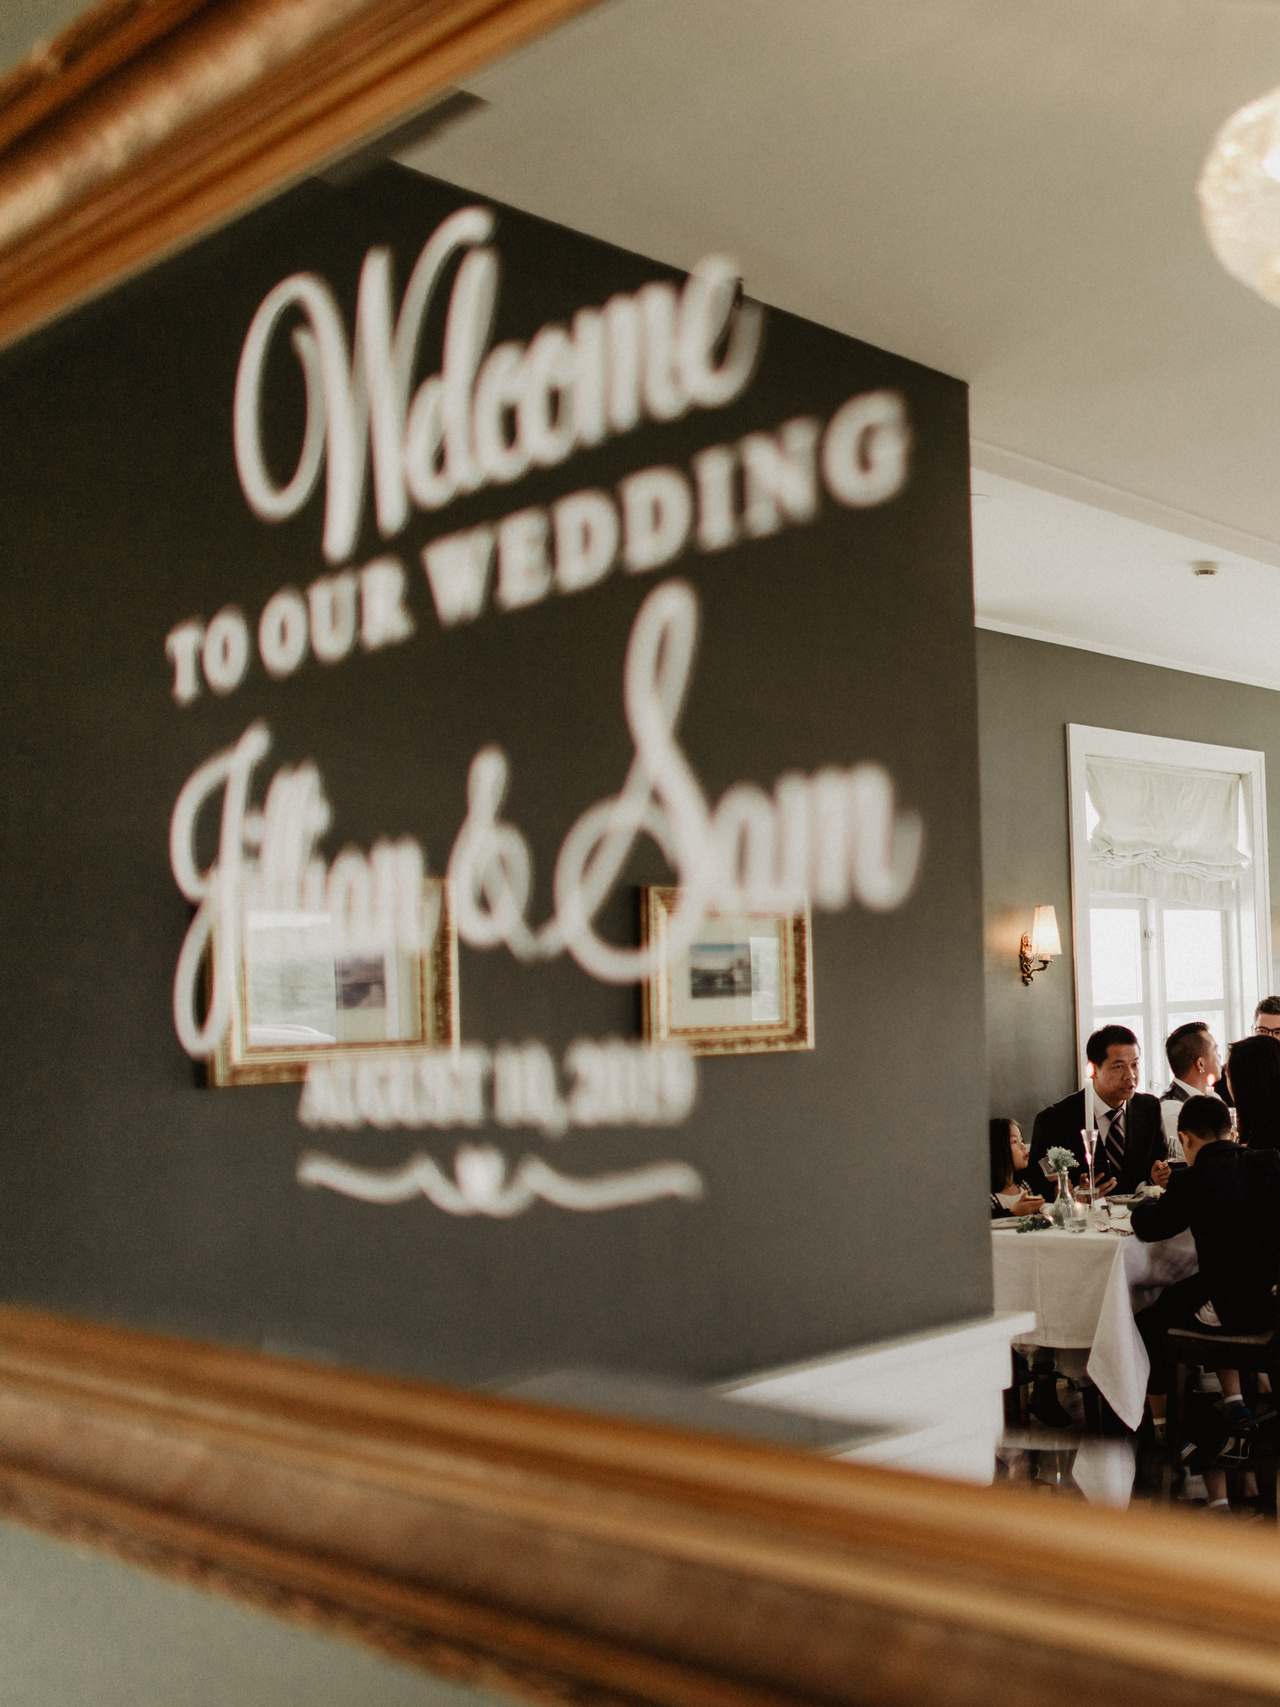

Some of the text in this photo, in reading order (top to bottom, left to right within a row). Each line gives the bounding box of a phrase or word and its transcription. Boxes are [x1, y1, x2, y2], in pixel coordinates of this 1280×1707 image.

[165, 388, 914, 705] TO OUR WEDDING
[234, 206, 763, 563] Welcome
[552, 576, 924, 985] Sam
